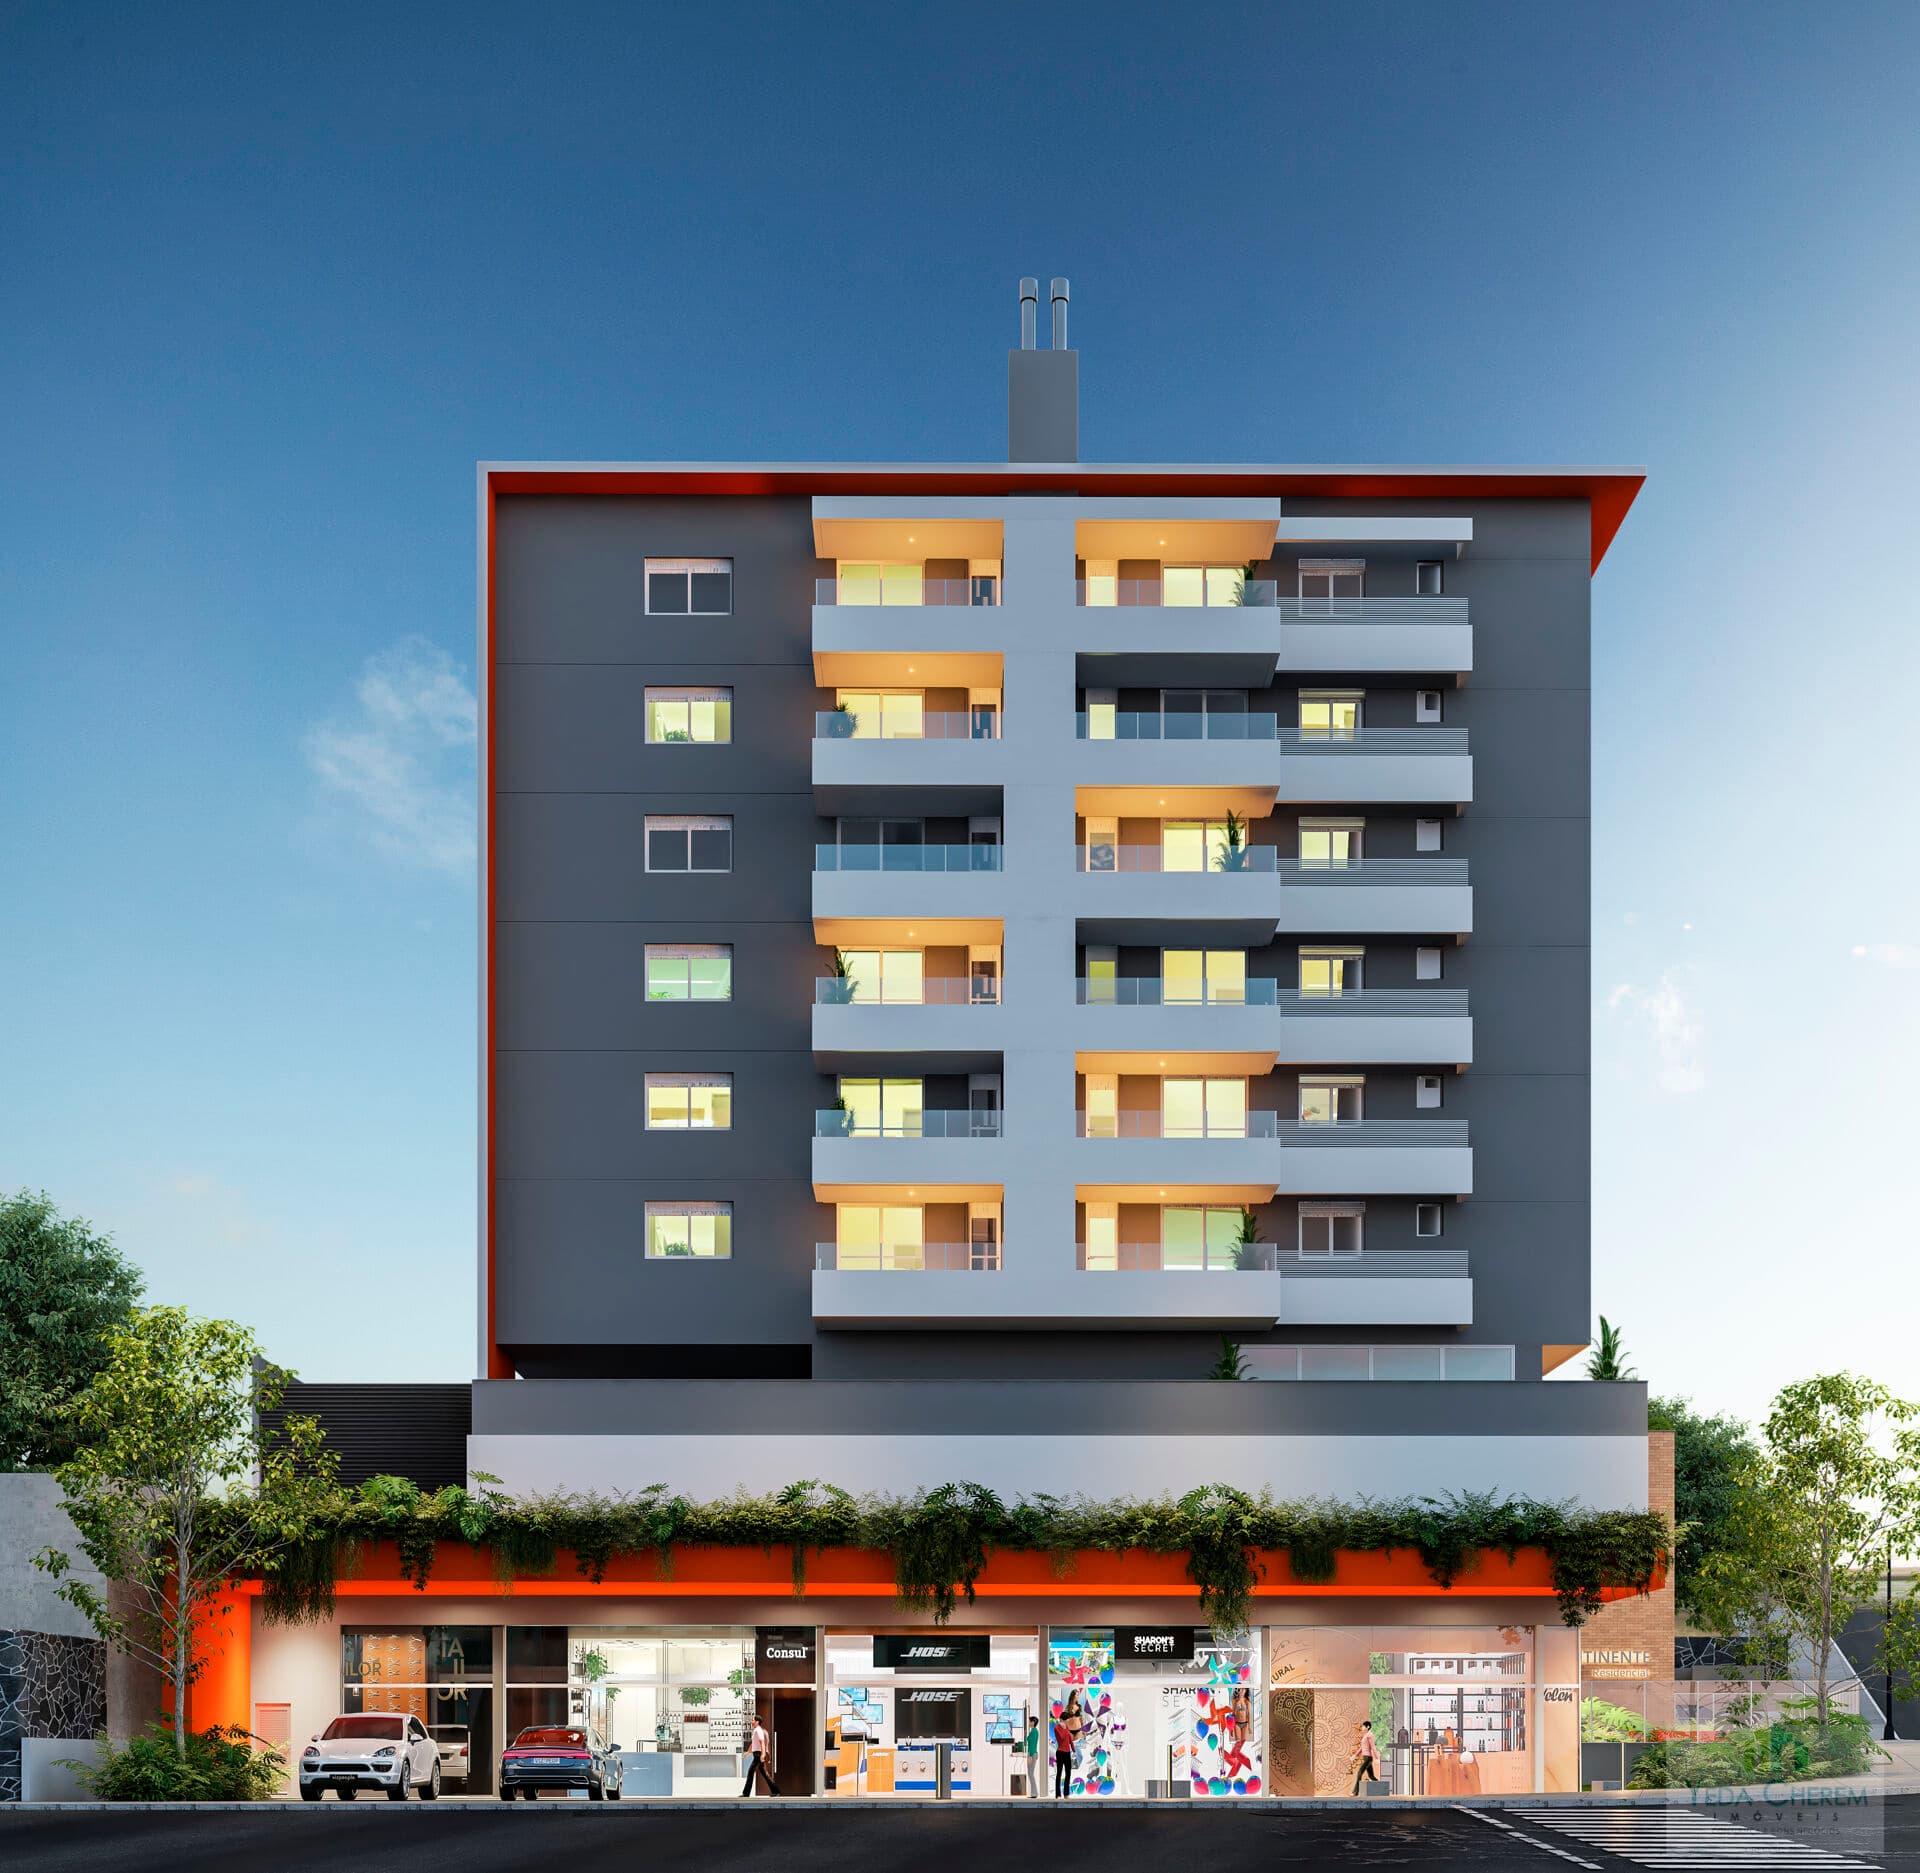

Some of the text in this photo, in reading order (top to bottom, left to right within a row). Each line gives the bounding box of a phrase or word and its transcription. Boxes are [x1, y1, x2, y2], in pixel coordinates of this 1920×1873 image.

[1134, 1636, 1174, 1644] SHARON'S
[766, 1647, 807, 1658] Consul
[1134, 1644, 1174, 1652] SECRET
[1271, 1663, 1295, 1684] URAL
[901, 1691, 964, 1702] HOSE
